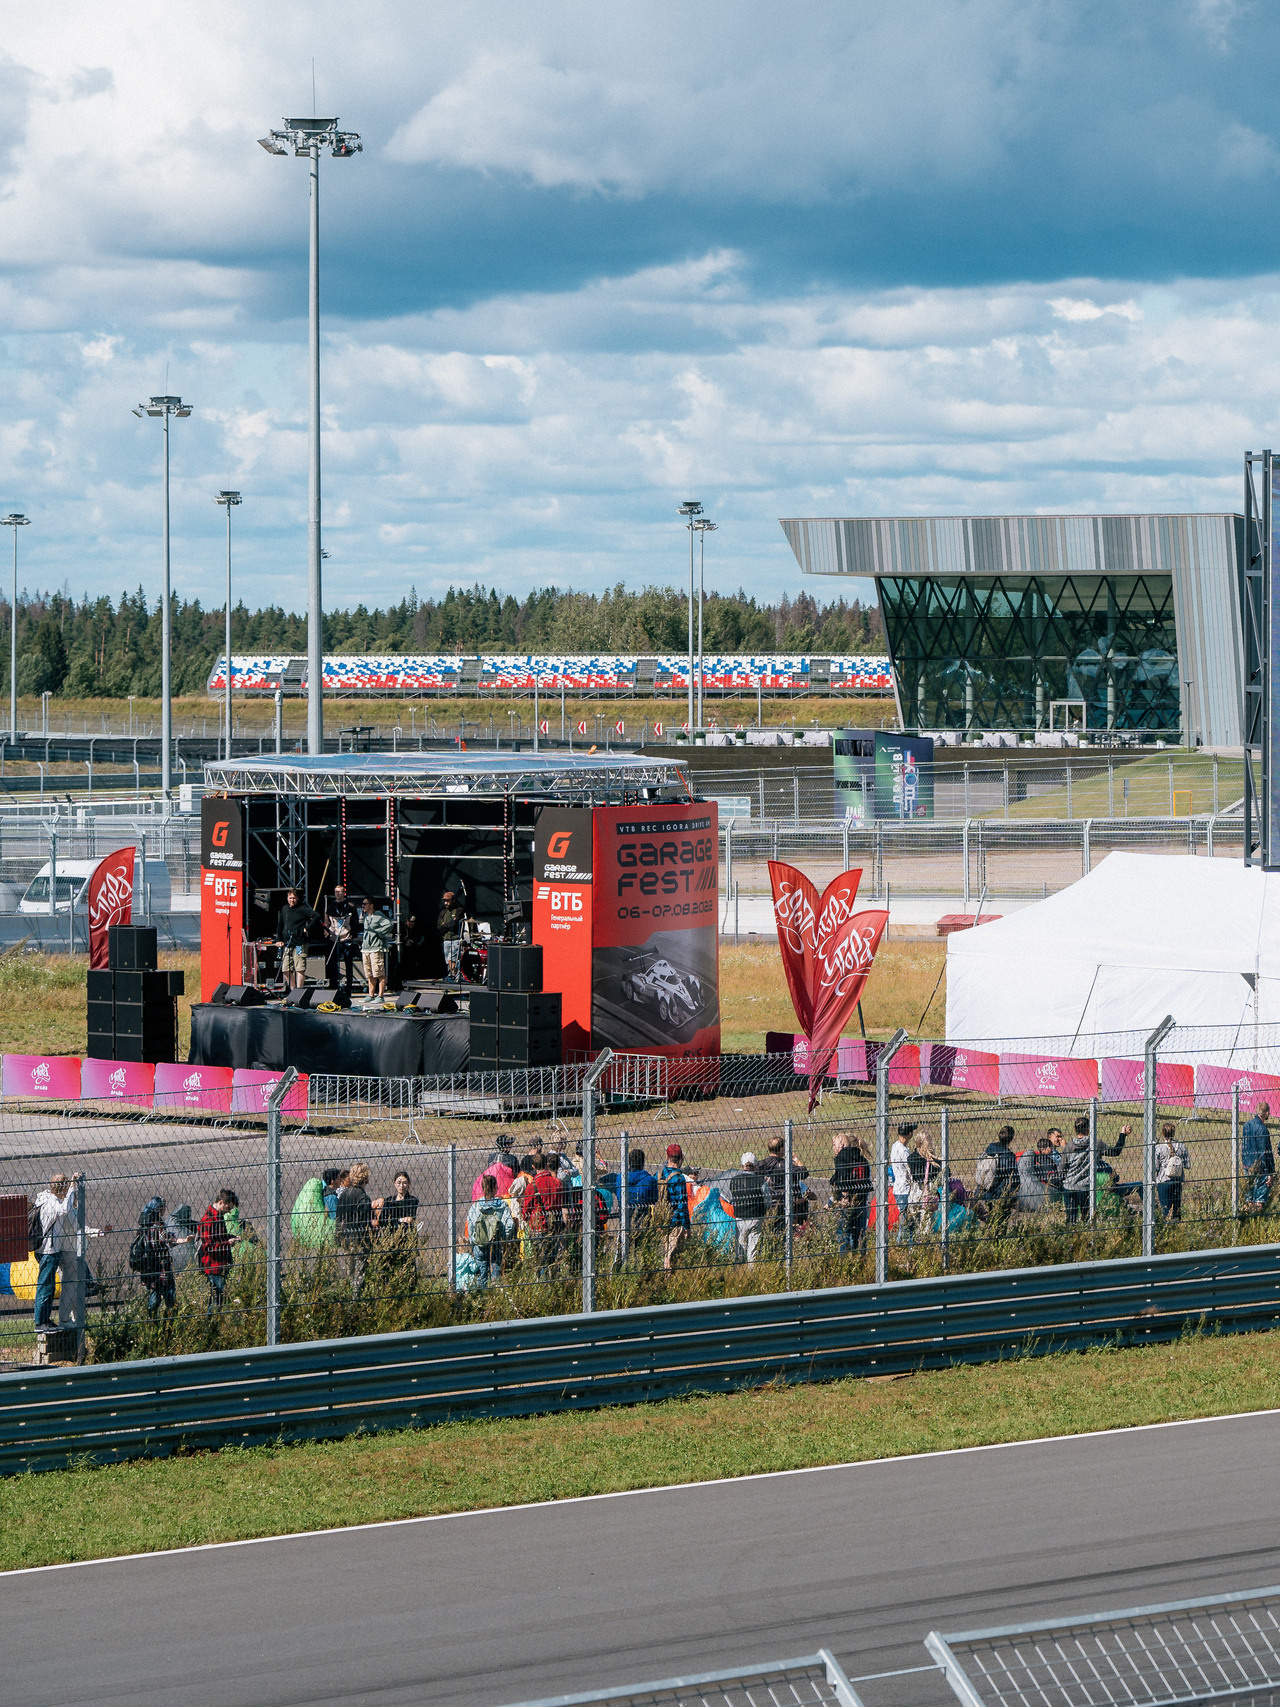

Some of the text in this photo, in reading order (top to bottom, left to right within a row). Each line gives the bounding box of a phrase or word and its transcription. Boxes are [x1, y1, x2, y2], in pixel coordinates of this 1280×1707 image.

[212, 821, 230, 847] G
[620, 825, 636, 833] VTB
[547, 831, 573, 859] G
[215, 878, 237, 897] ВТБ
[551, 891, 583, 911] ВТБ
